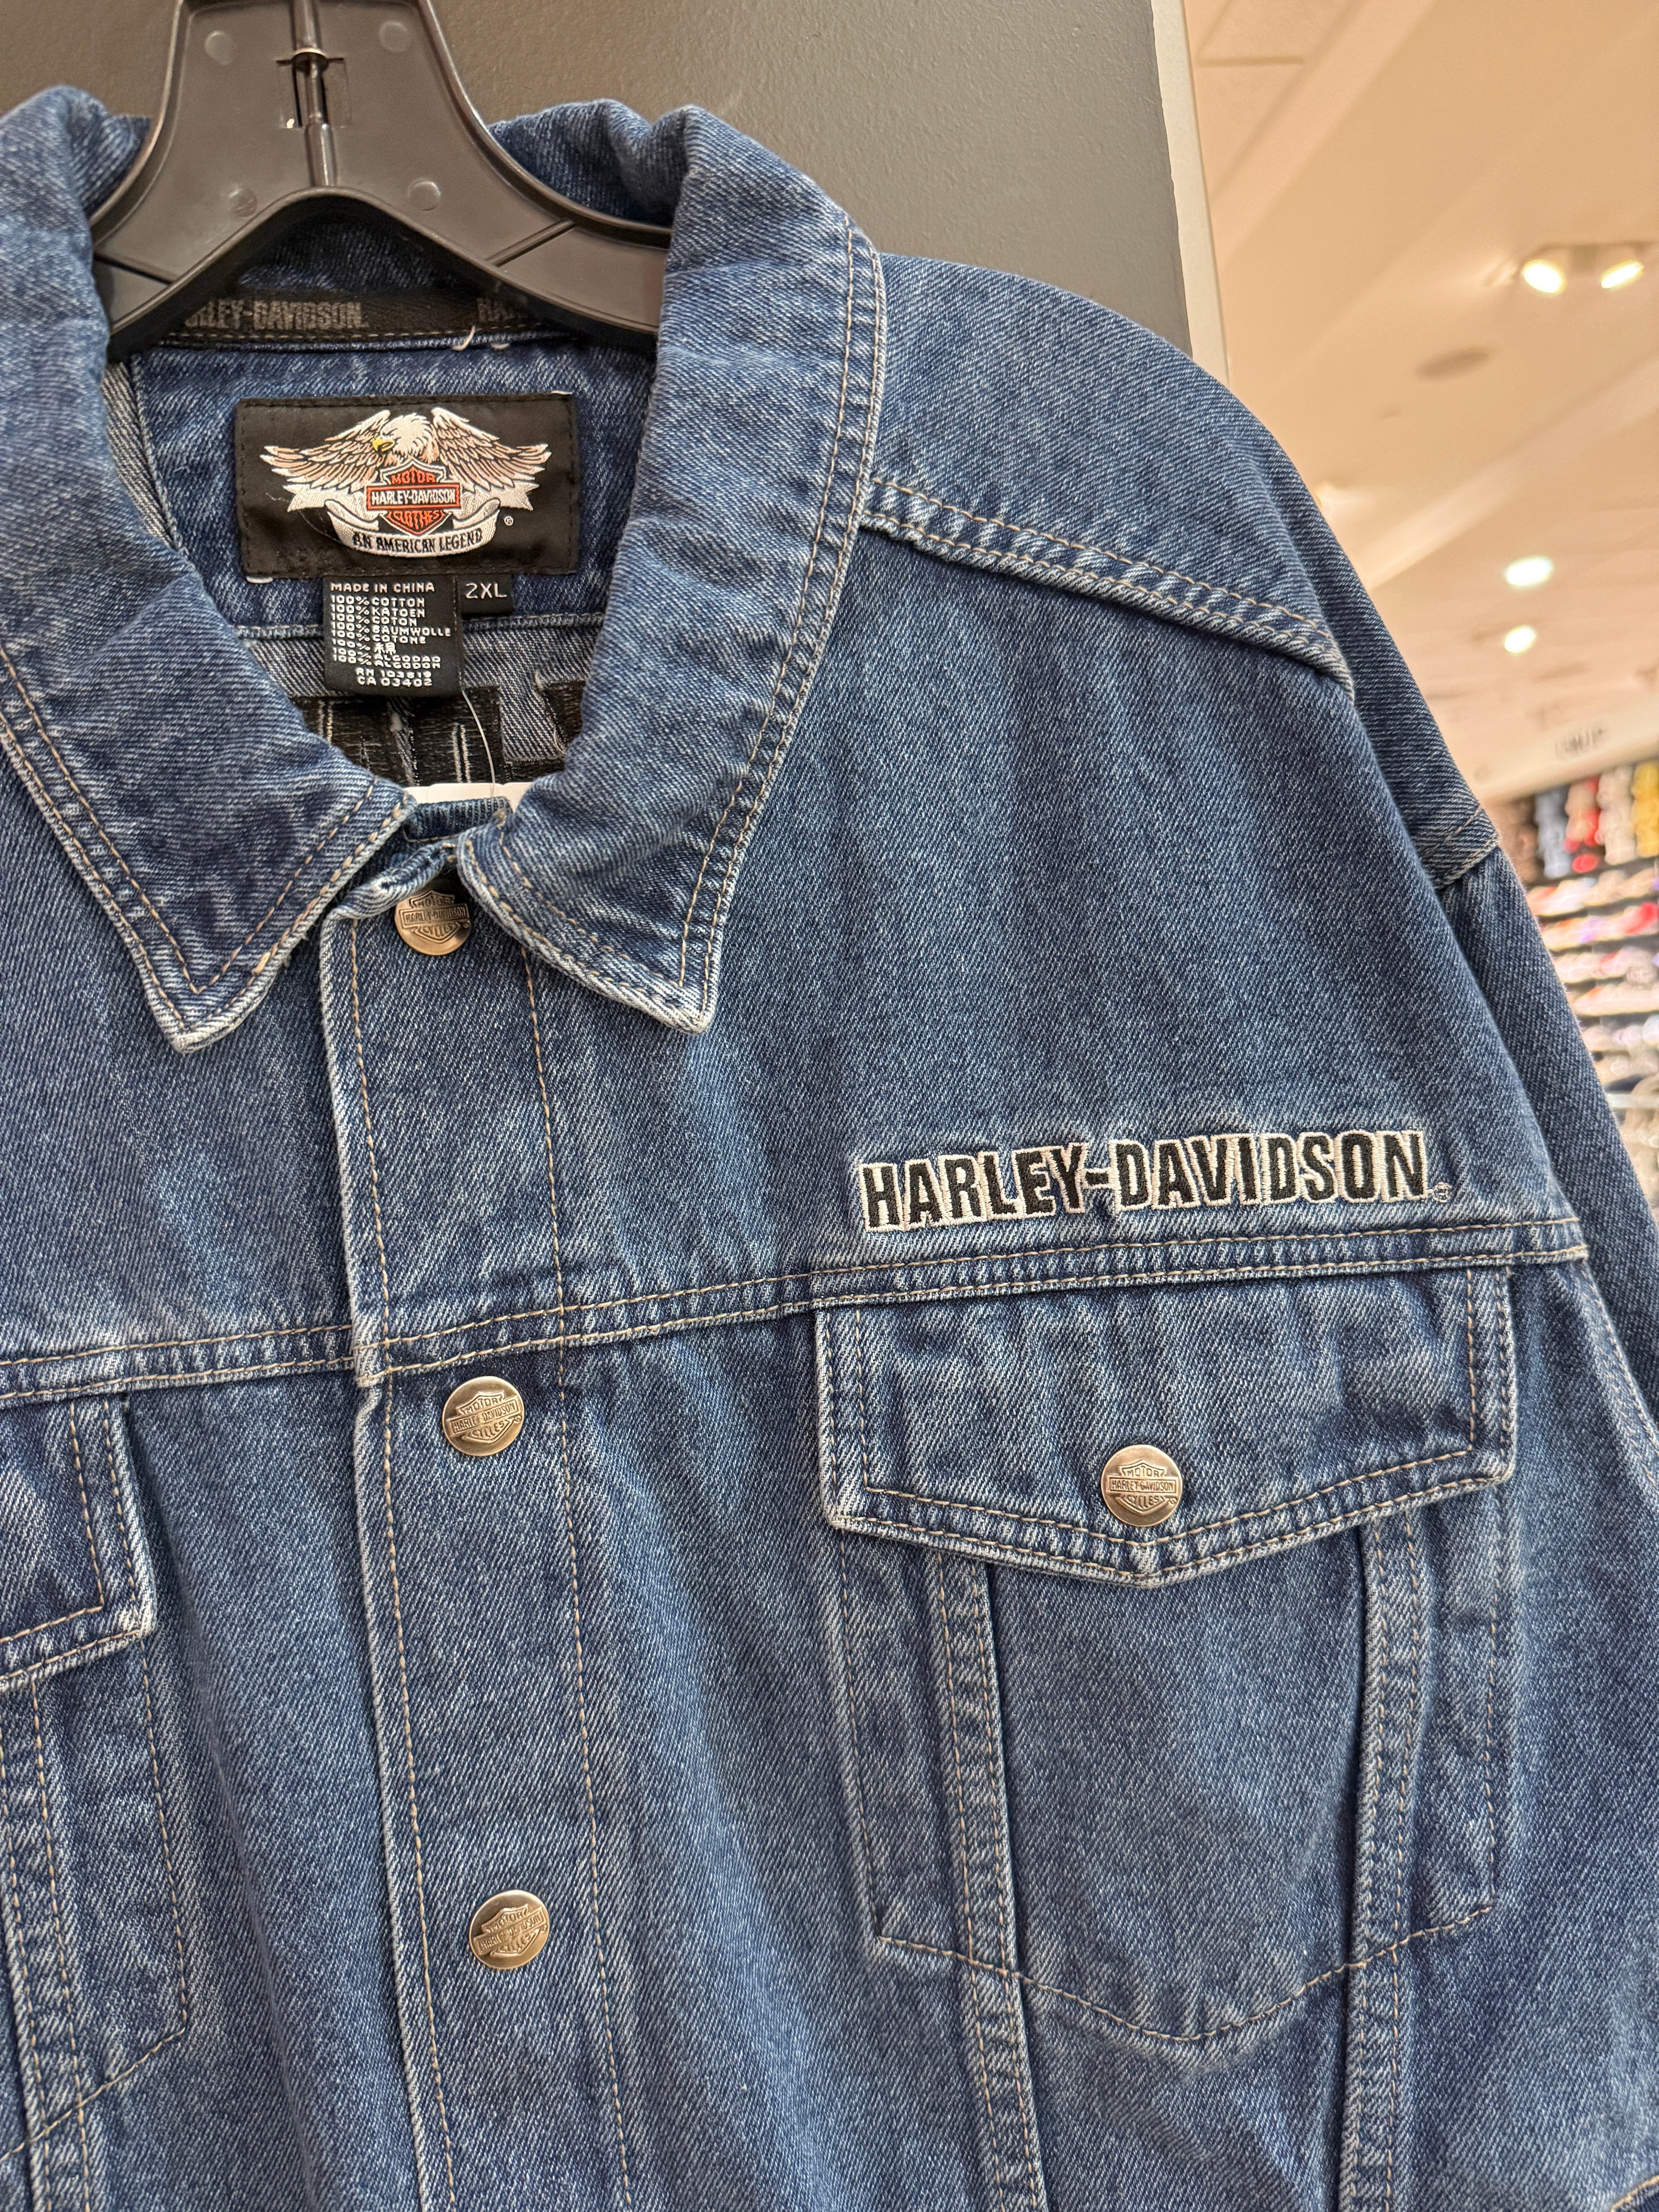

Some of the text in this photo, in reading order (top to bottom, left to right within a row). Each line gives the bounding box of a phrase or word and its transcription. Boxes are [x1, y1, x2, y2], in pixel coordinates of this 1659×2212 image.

[391, 467, 436, 485] MOTOR
[371, 489, 456, 505] HARLEY-DAVIDSON
[393, 510, 440, 530] CLOTHES
[352, 528, 483, 553] AN AMERICAN LEGEND
[331, 582, 434, 593] MADE IN CHINA
[465, 583, 507, 599] 2XL
[331, 595, 425, 607] 100% COTTON
[331, 604, 425, 618] 100% KATOEN
[331, 613, 417, 627] 100% COTON
[331, 622, 451, 637] 100% BAUMWOLLE
[331, 630, 426, 644] 100% COTONE
[332, 639, 371, 651] 100%
[333, 654, 372, 666] 100%
[356, 667, 374, 676] RN
[357, 676, 432, 687] CA 03402
[858, 1130, 1428, 1232] HARLEY-DAVIDSON
[465, 1398, 499, 1413] MOTOR
[472, 1420, 504, 1439] CYCLES
[1127, 1466, 1159, 1477] MOTOR
[1111, 1479, 1173, 1492] HARLEY-DAVIDSON
[1126, 1496, 1159, 1509] CYCLES
